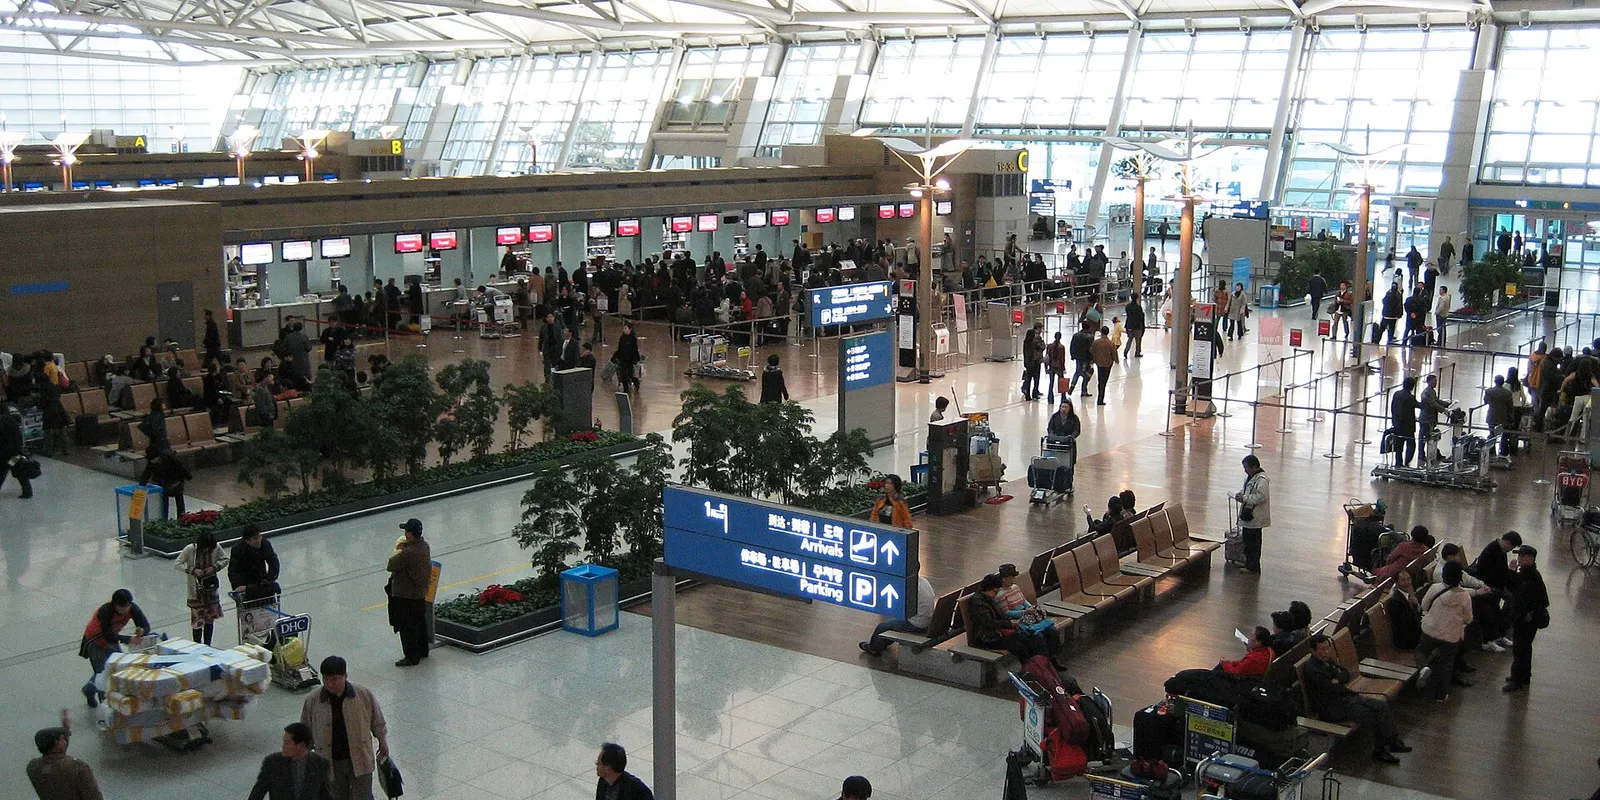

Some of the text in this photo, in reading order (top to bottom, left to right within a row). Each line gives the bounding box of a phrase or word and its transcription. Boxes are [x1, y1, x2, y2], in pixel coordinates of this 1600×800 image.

[135, 136, 145, 147] A
[391, 139, 402, 155] B
[1017, 150, 1028, 172] C
[1563, 476, 1583, 487] BYC
[800, 537, 844, 558] Arrivals
[800, 579, 843, 602] Parking
[855, 578, 872, 600] P
[281, 619, 305, 633] DHC
